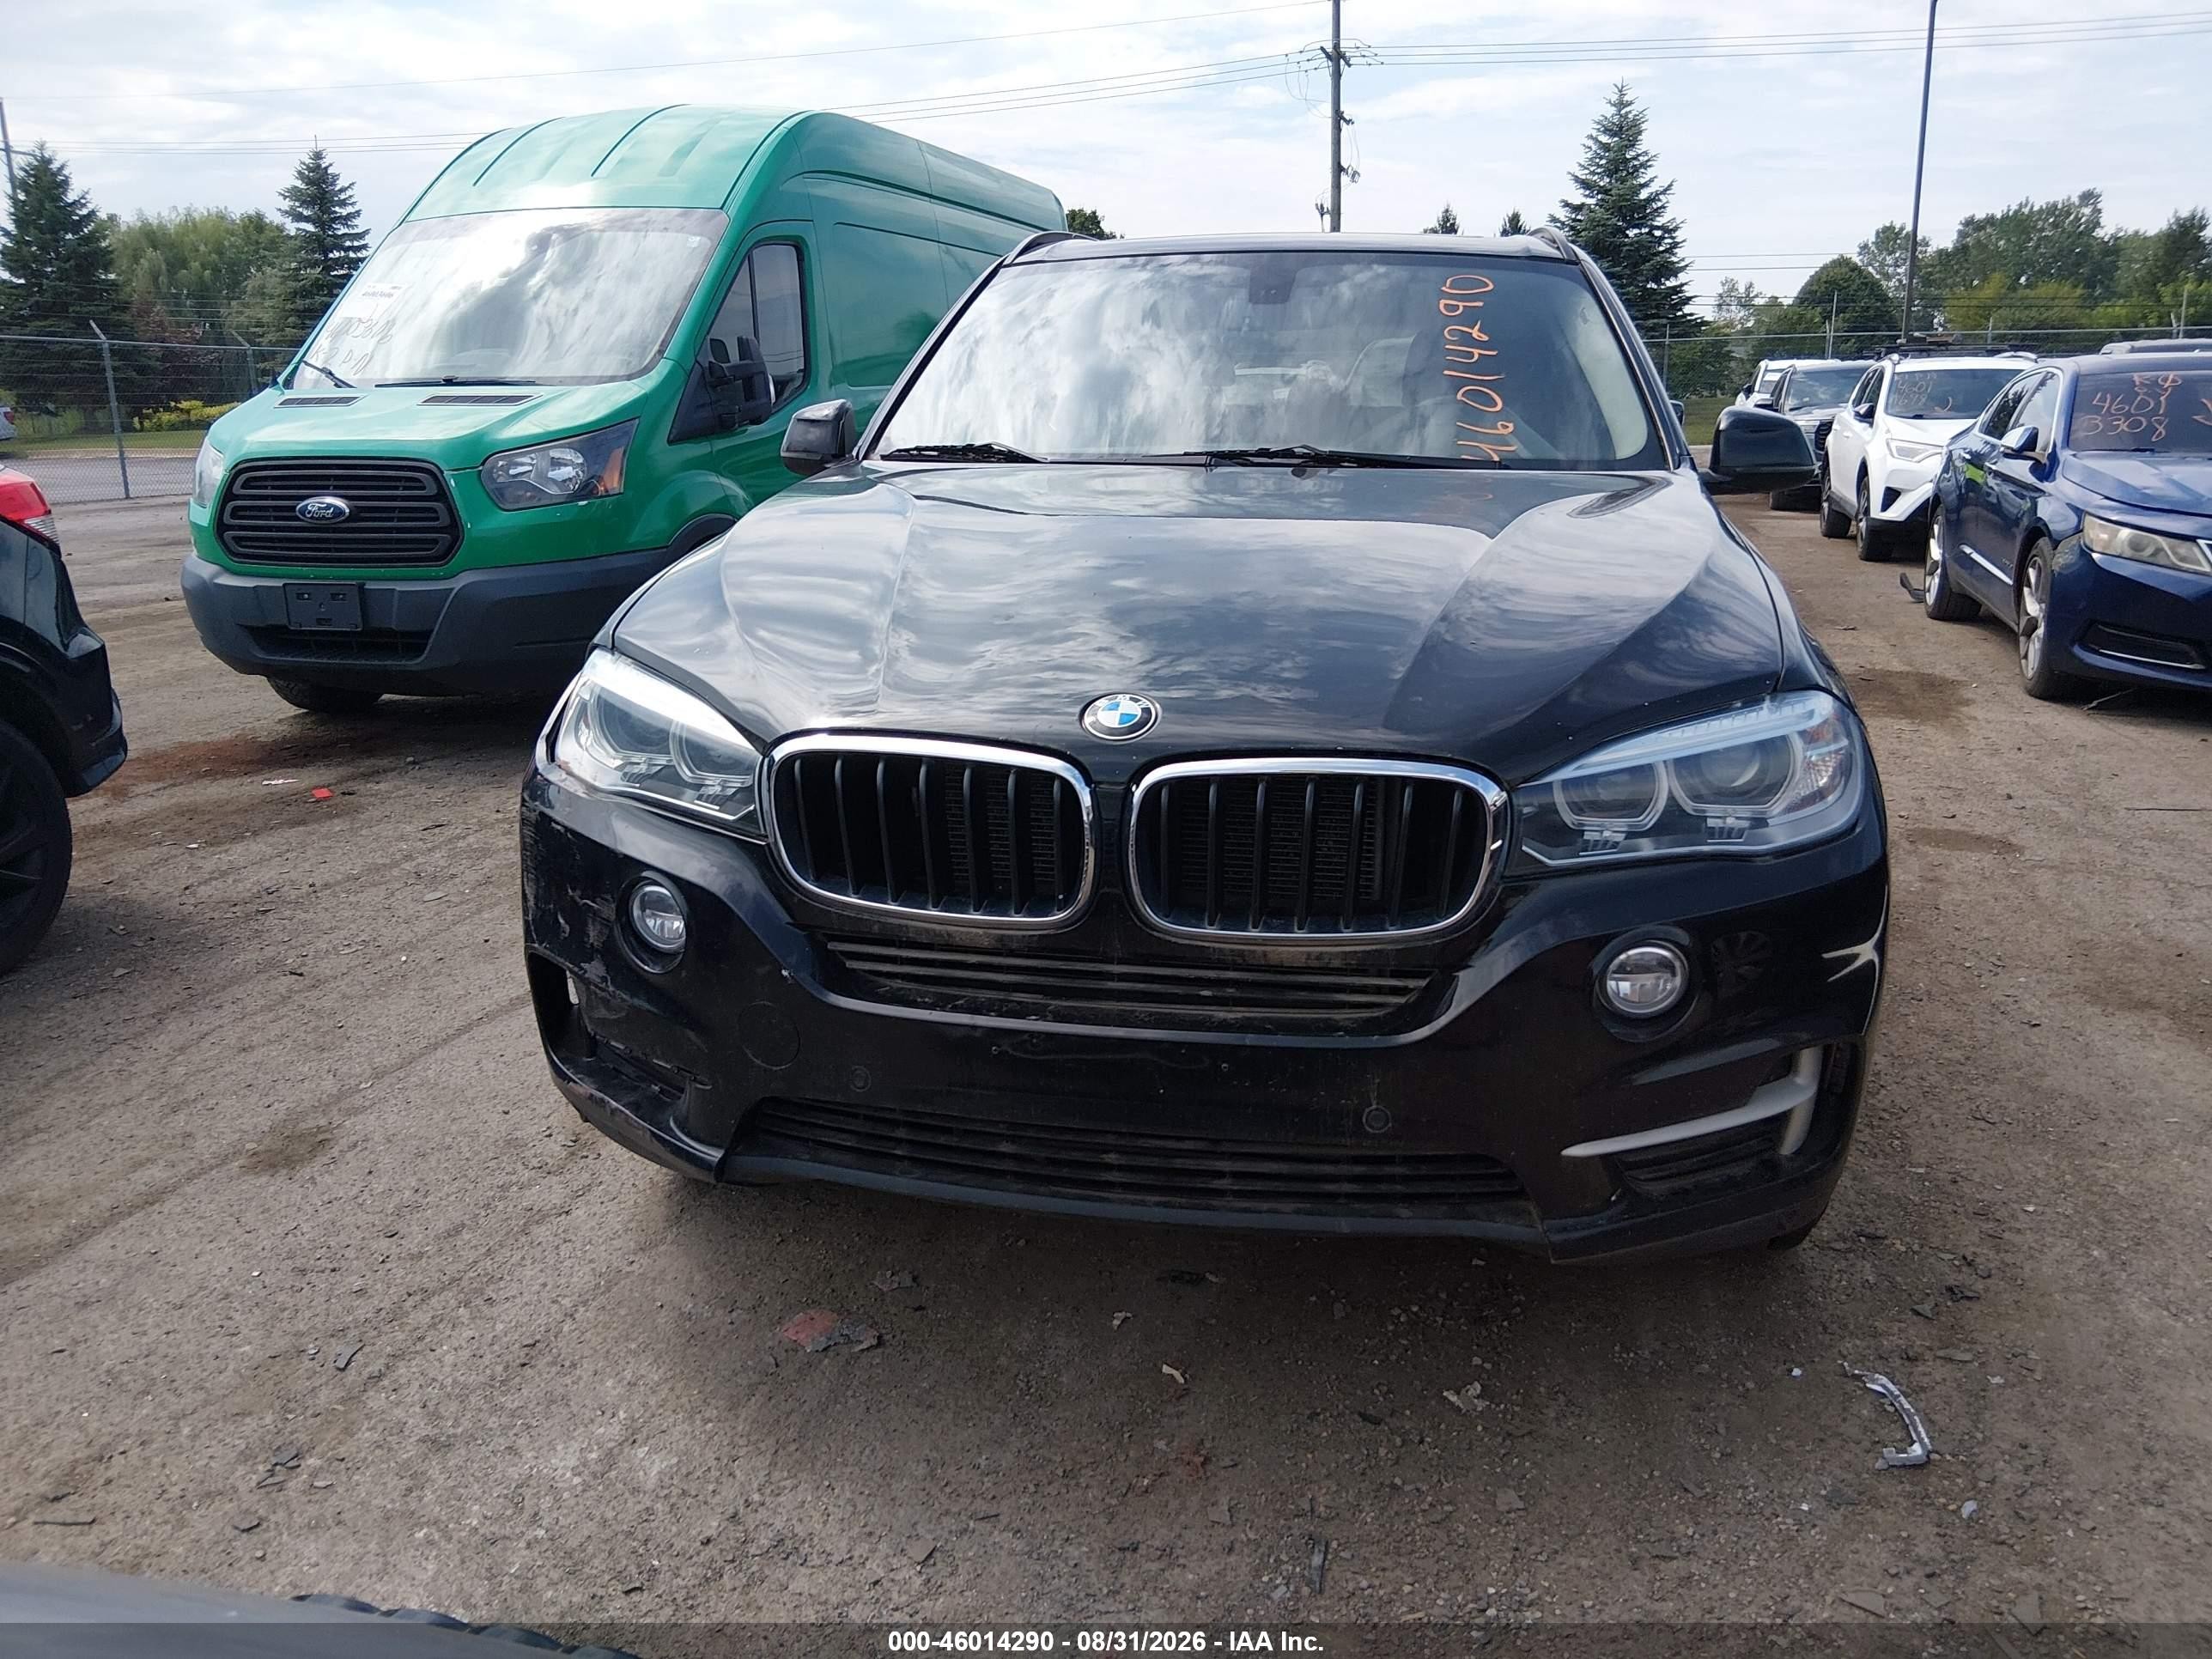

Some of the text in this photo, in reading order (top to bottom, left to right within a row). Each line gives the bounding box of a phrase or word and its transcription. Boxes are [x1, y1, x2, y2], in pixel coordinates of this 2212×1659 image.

[1438, 275, 1518, 461] 46014290
[1897, 380, 1933, 393] 4601
[2092, 392, 2166, 414] 4601
[2080, 415, 2169, 442] 3308
[305, 503, 334, 518] Ford
